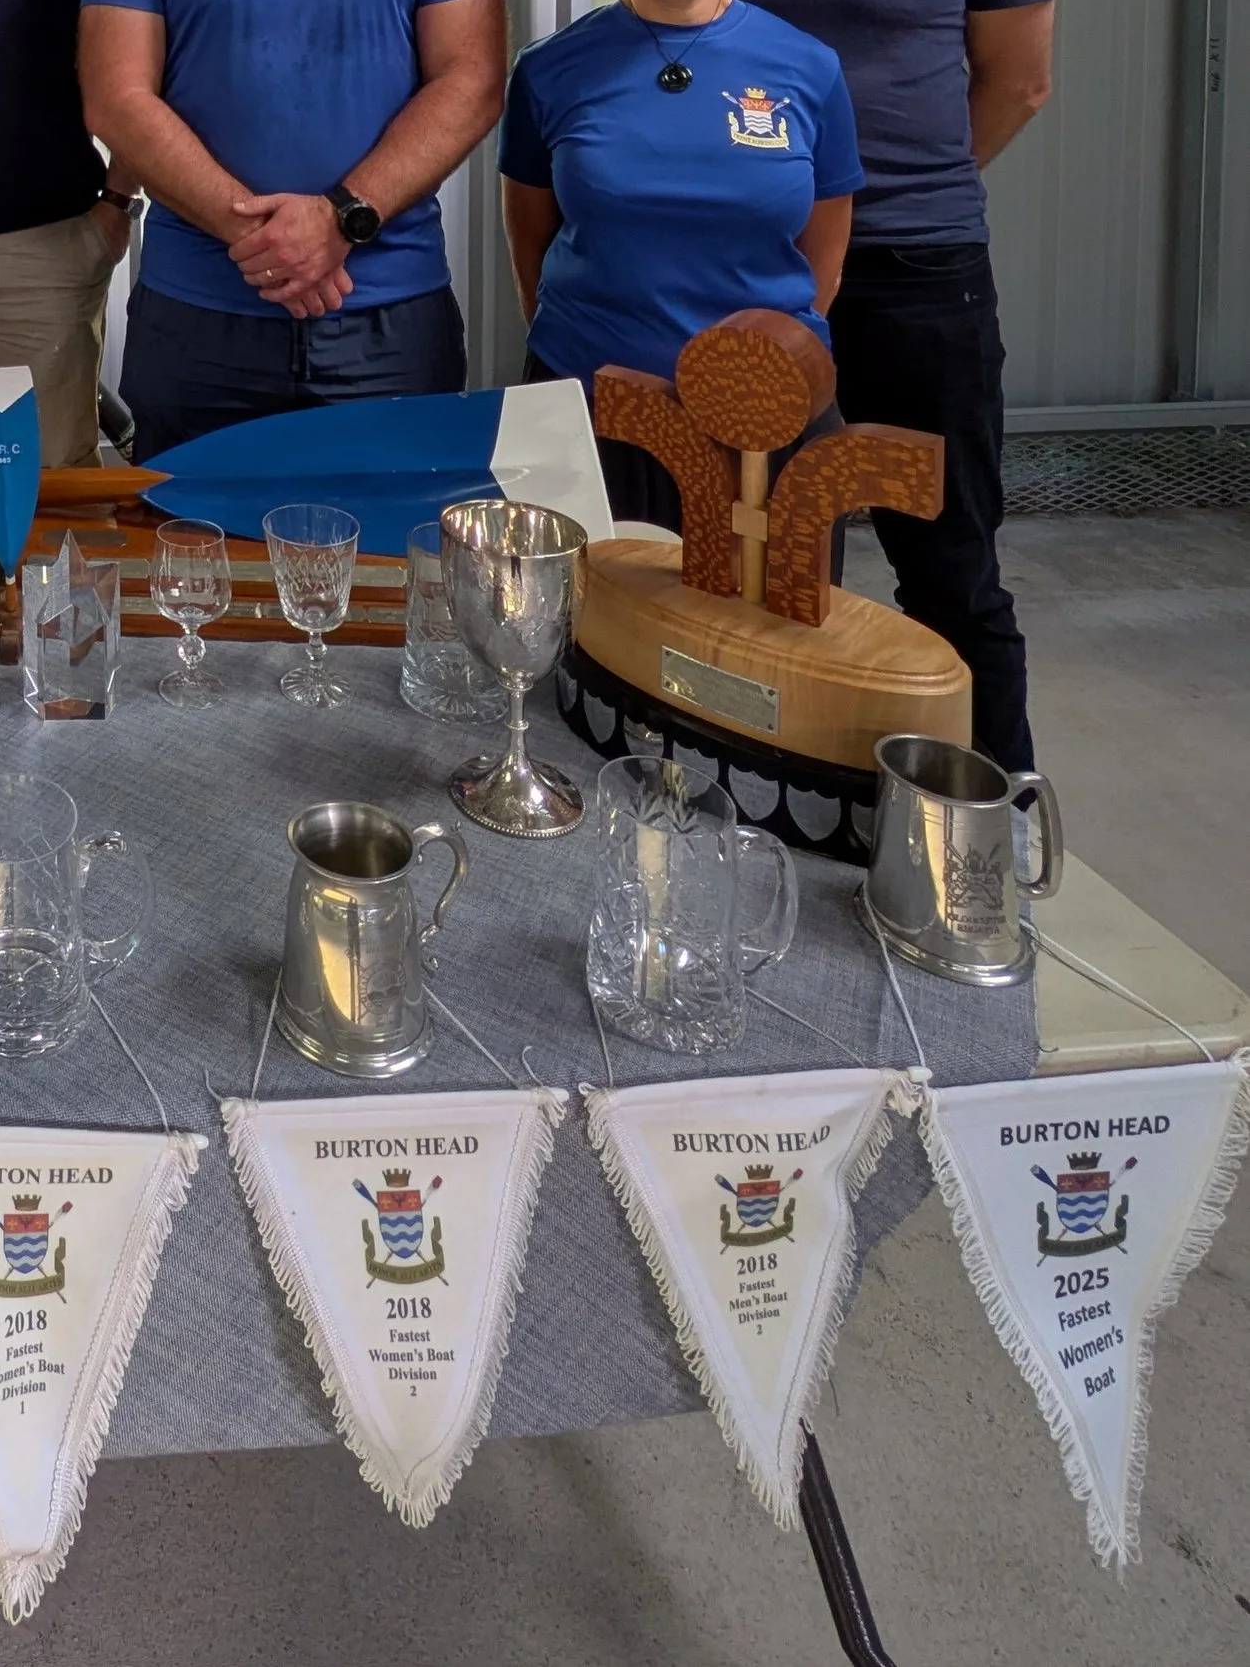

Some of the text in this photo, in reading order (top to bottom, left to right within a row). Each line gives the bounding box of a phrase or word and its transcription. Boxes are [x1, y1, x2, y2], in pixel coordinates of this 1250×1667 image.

[673, 1125, 831, 1154] BURTON HEAD
[1000, 1115, 1171, 1146] BURTON HEAD
[314, 1135, 479, 1160] BURTON HEAD
[48, 1167, 114, 1184] HEAD
[736, 1252, 778, 1276] 2018
[739, 1278, 775, 1294] Fastest
[1053, 1267, 1110, 1299] 2025
[385, 1297, 432, 1320] 2018
[729, 1291, 788, 1312] Men's Boat
[4, 1309, 48, 1338] 2018
[738, 1307, 780, 1325] Division
[1057, 1300, 1112, 1332] Fastest
[389, 1329, 431, 1343] Fastest
[756, 1324, 763, 1335] 2
[5, 1341, 44, 1362] Fastest
[368, 1348, 455, 1363] Women's Boat
[1058, 1325, 1124, 1398] Women's Boat
[38, 1359, 65, 1375] Boat
[388, 1366, 438, 1381] Division
[1, 1380, 47, 1402] Division
[410, 1385, 417, 1397] 2
[19, 1401, 26, 1415] 1
